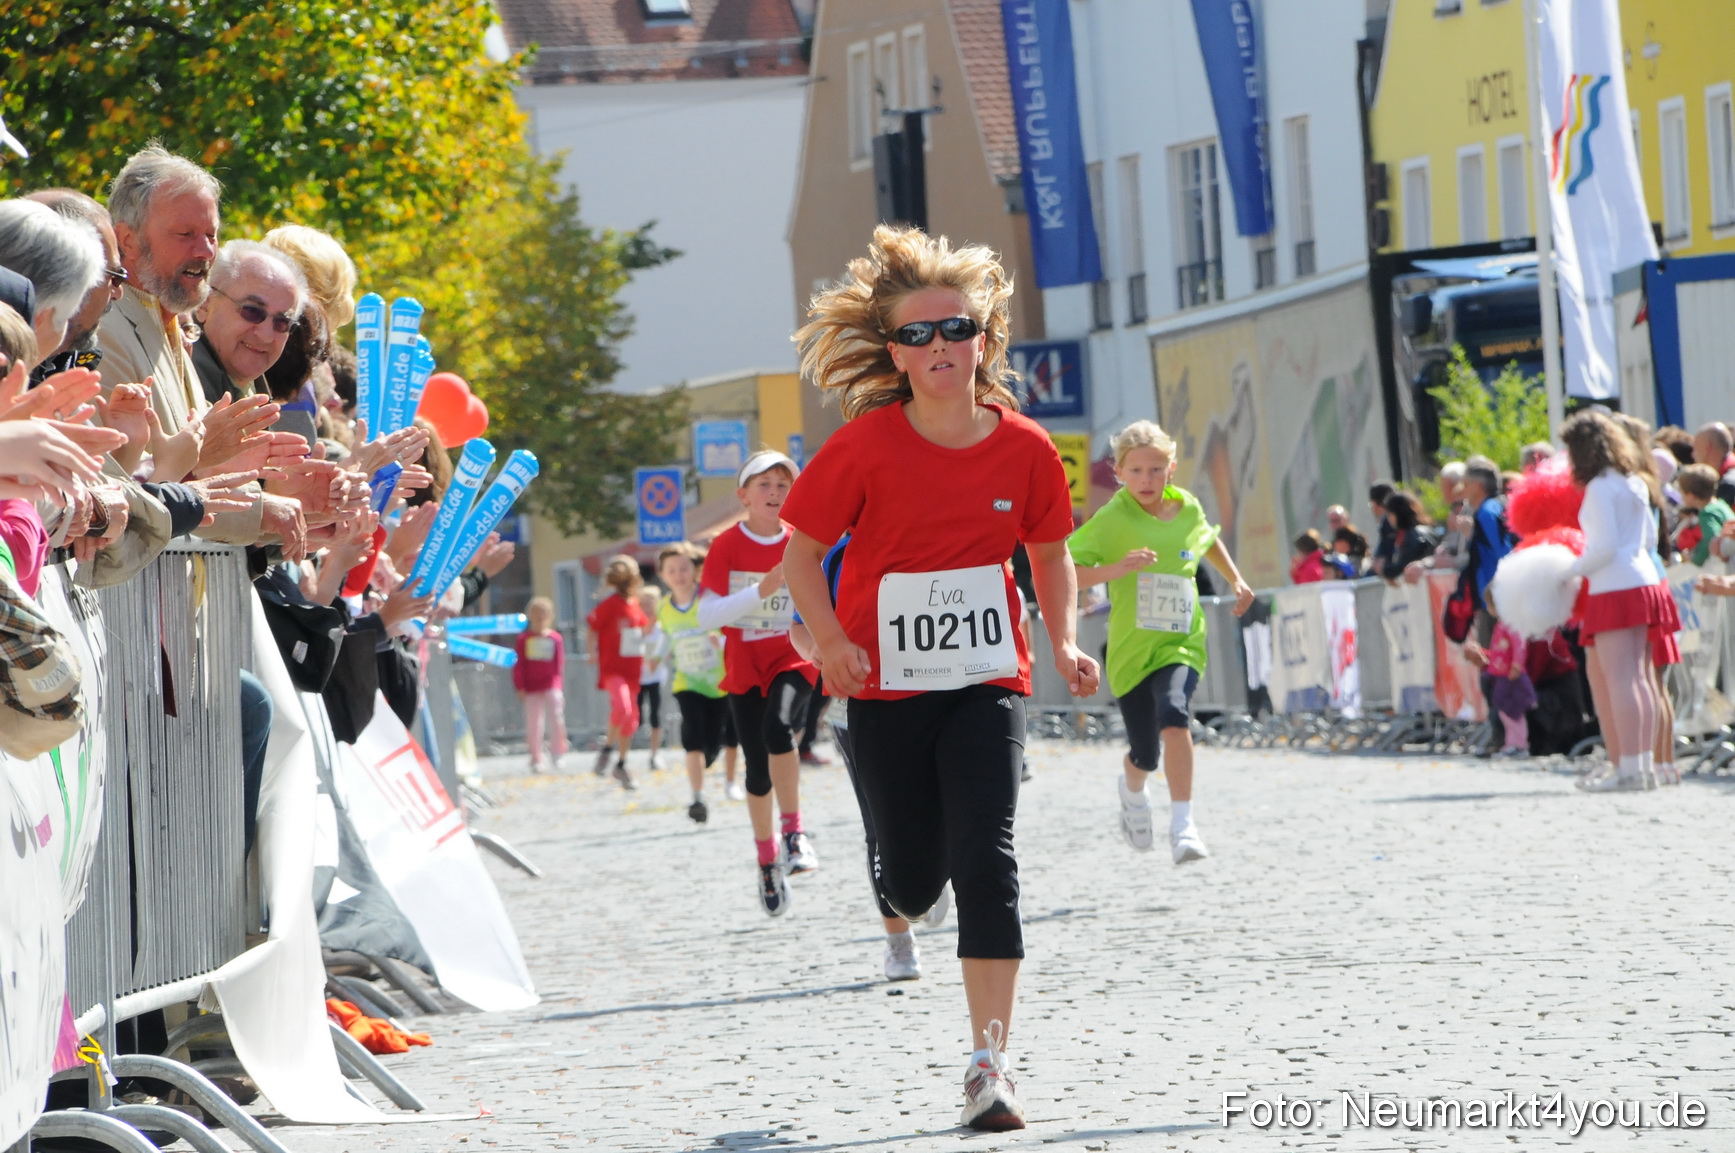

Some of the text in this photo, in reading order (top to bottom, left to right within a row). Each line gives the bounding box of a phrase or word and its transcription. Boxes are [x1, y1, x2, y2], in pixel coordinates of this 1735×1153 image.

[1466, 73, 1517, 127] HOTEL
[928, 580, 965, 606] Eva
[889, 608, 1003, 652] 10210
[914, 667, 952, 675] PFLEIDERER
